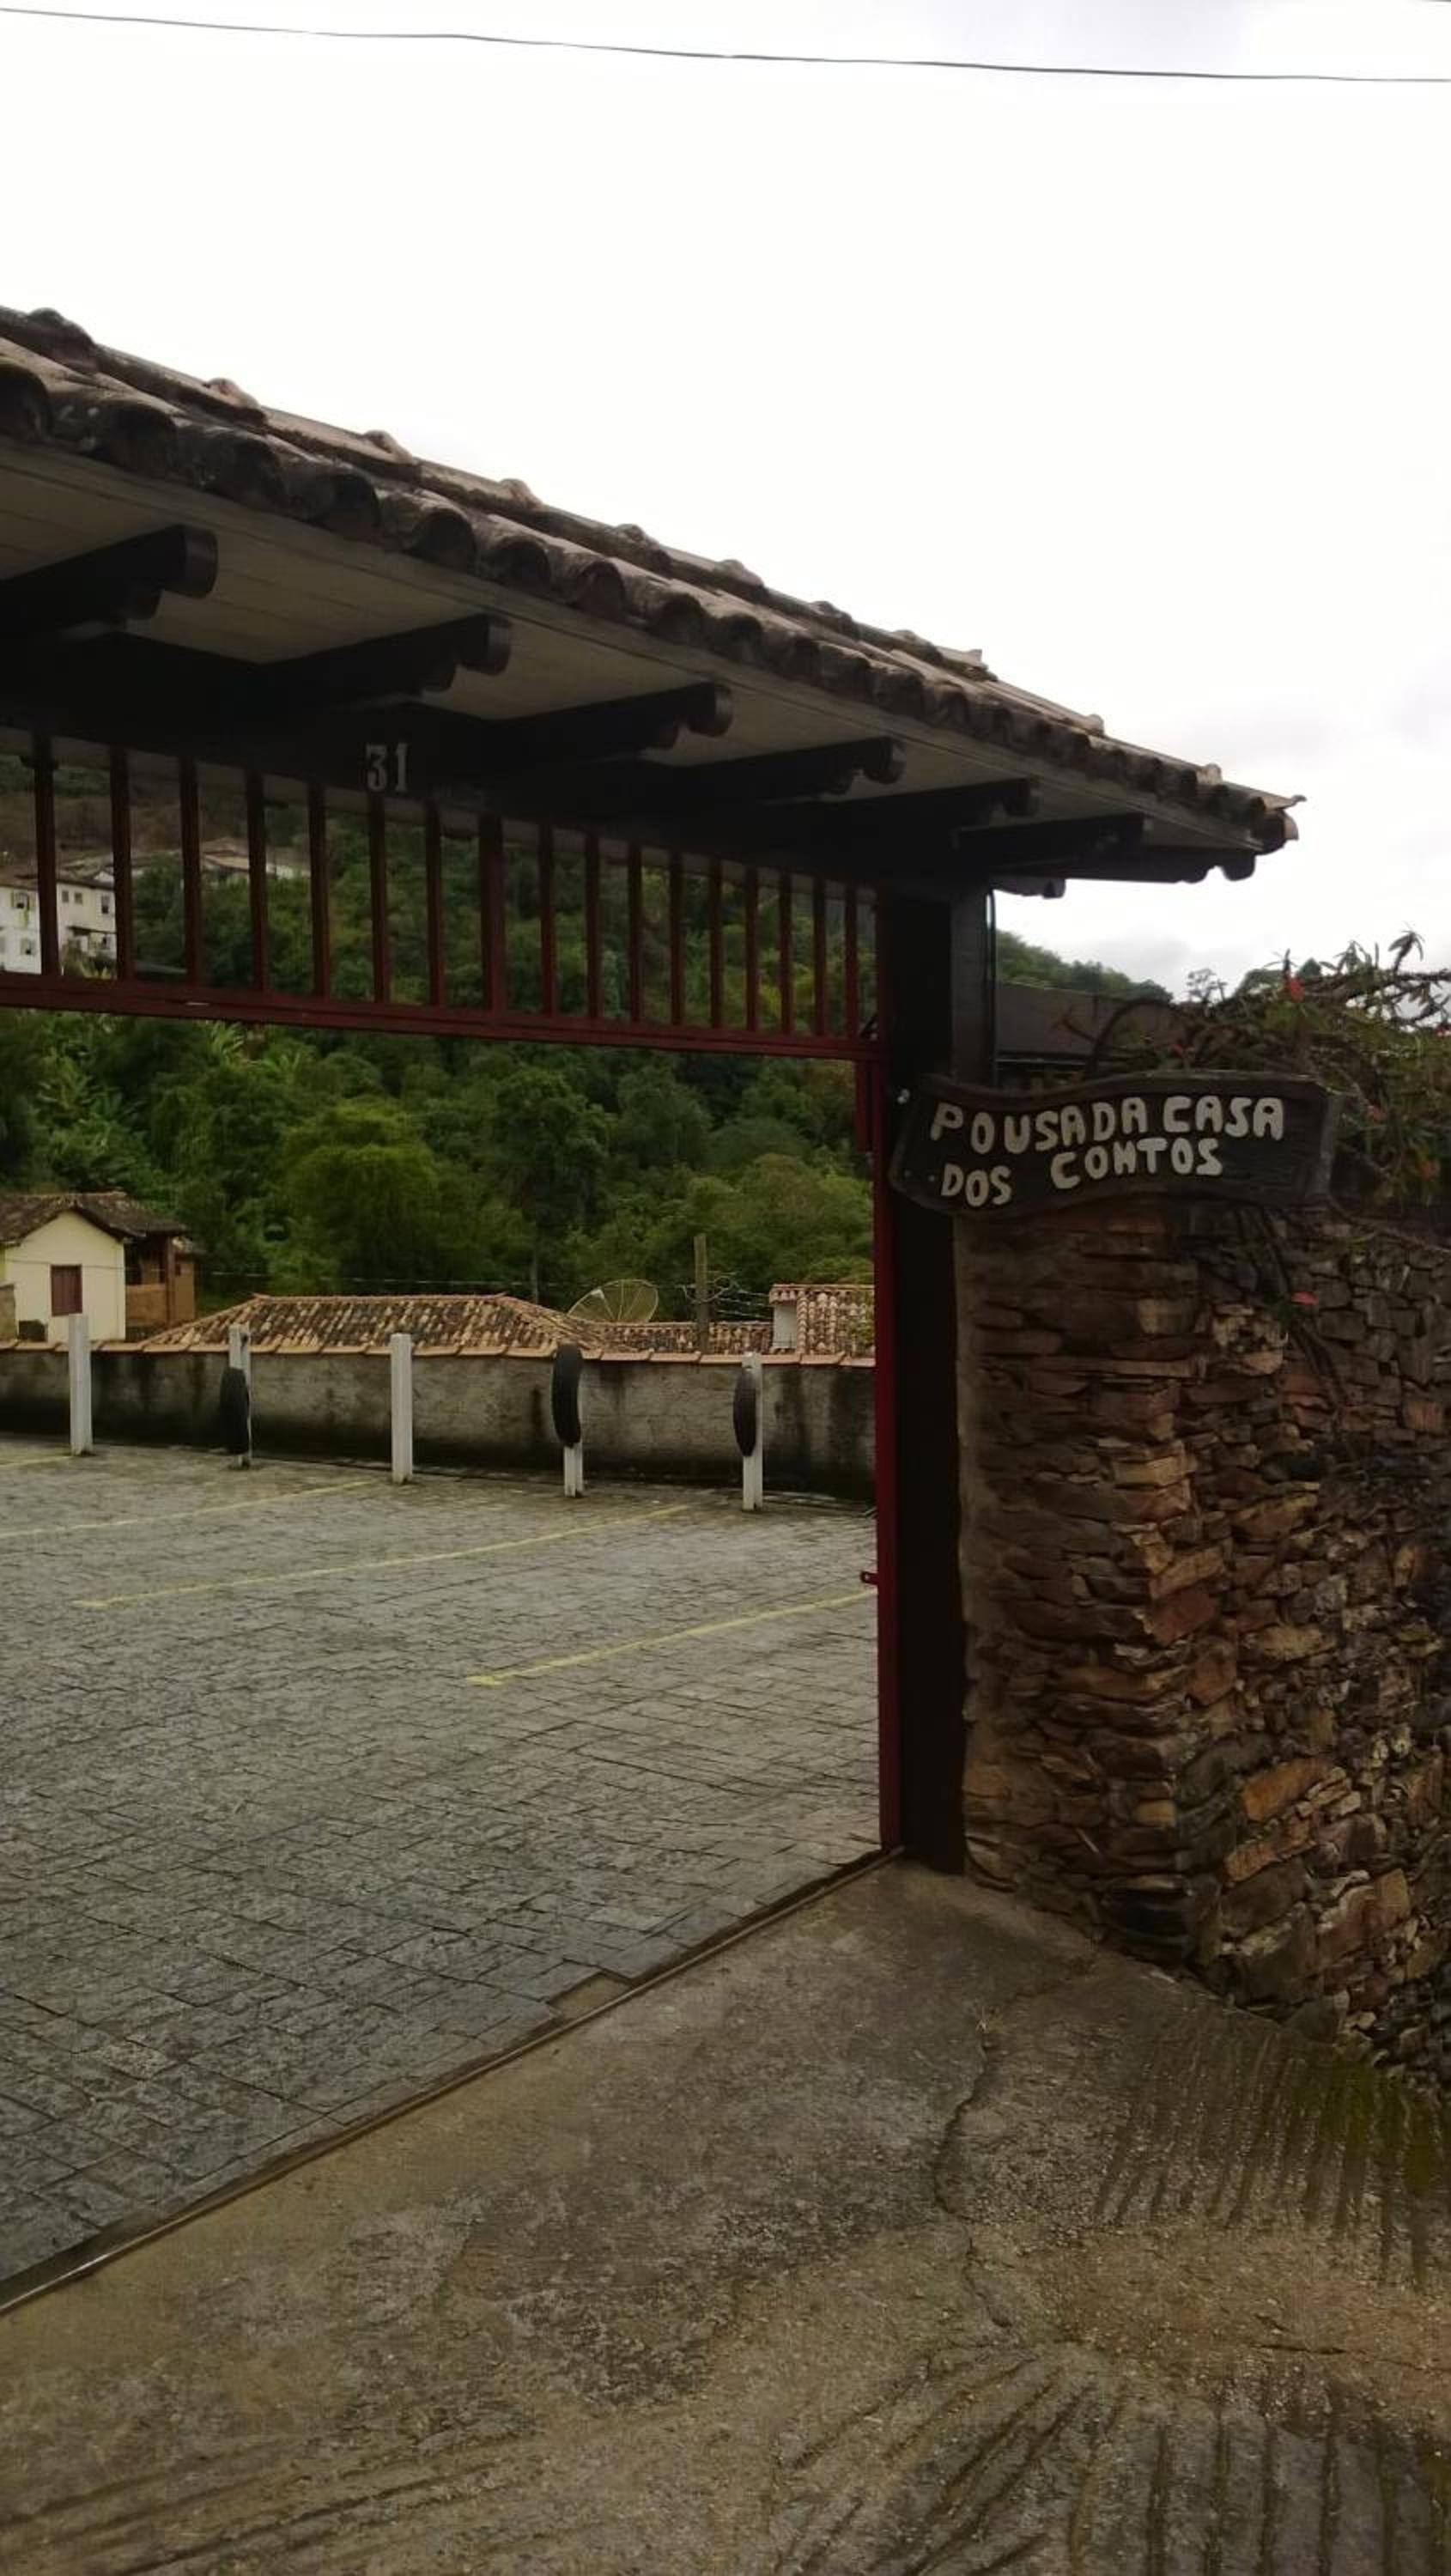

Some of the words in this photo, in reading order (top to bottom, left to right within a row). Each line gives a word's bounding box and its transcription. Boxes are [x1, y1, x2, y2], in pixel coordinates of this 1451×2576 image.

[365, 742, 408, 792] 31
[930, 1096, 1148, 1155] POUSADA
[1163, 1095, 1284, 1140] CASA
[941, 1163, 1011, 1207] DOS
[1050, 1137, 1223, 1190] CONTOS
